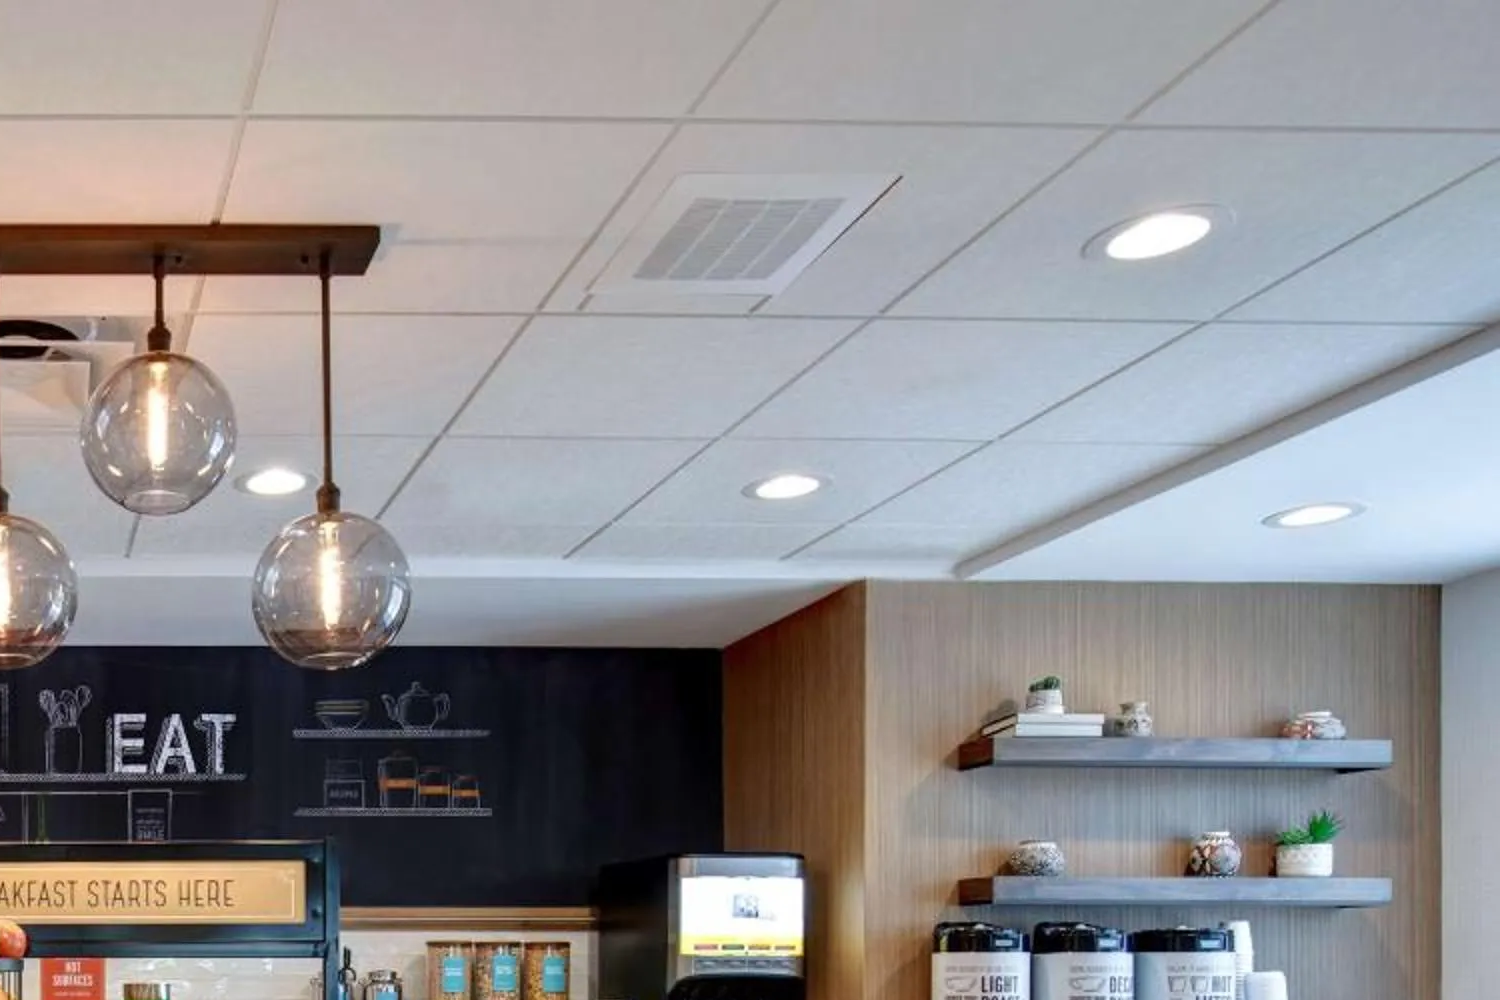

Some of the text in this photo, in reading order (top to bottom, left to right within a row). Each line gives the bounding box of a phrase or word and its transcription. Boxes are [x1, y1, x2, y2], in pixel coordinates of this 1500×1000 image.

[106, 713, 236, 775] EAT
[87, 879, 168, 908] STARTS
[178, 879, 235, 908] HERE
[52, 974, 94, 987] SURFACES
[981, 975, 1019, 993] LIGHT
[1211, 975, 1233, 993] HOT
